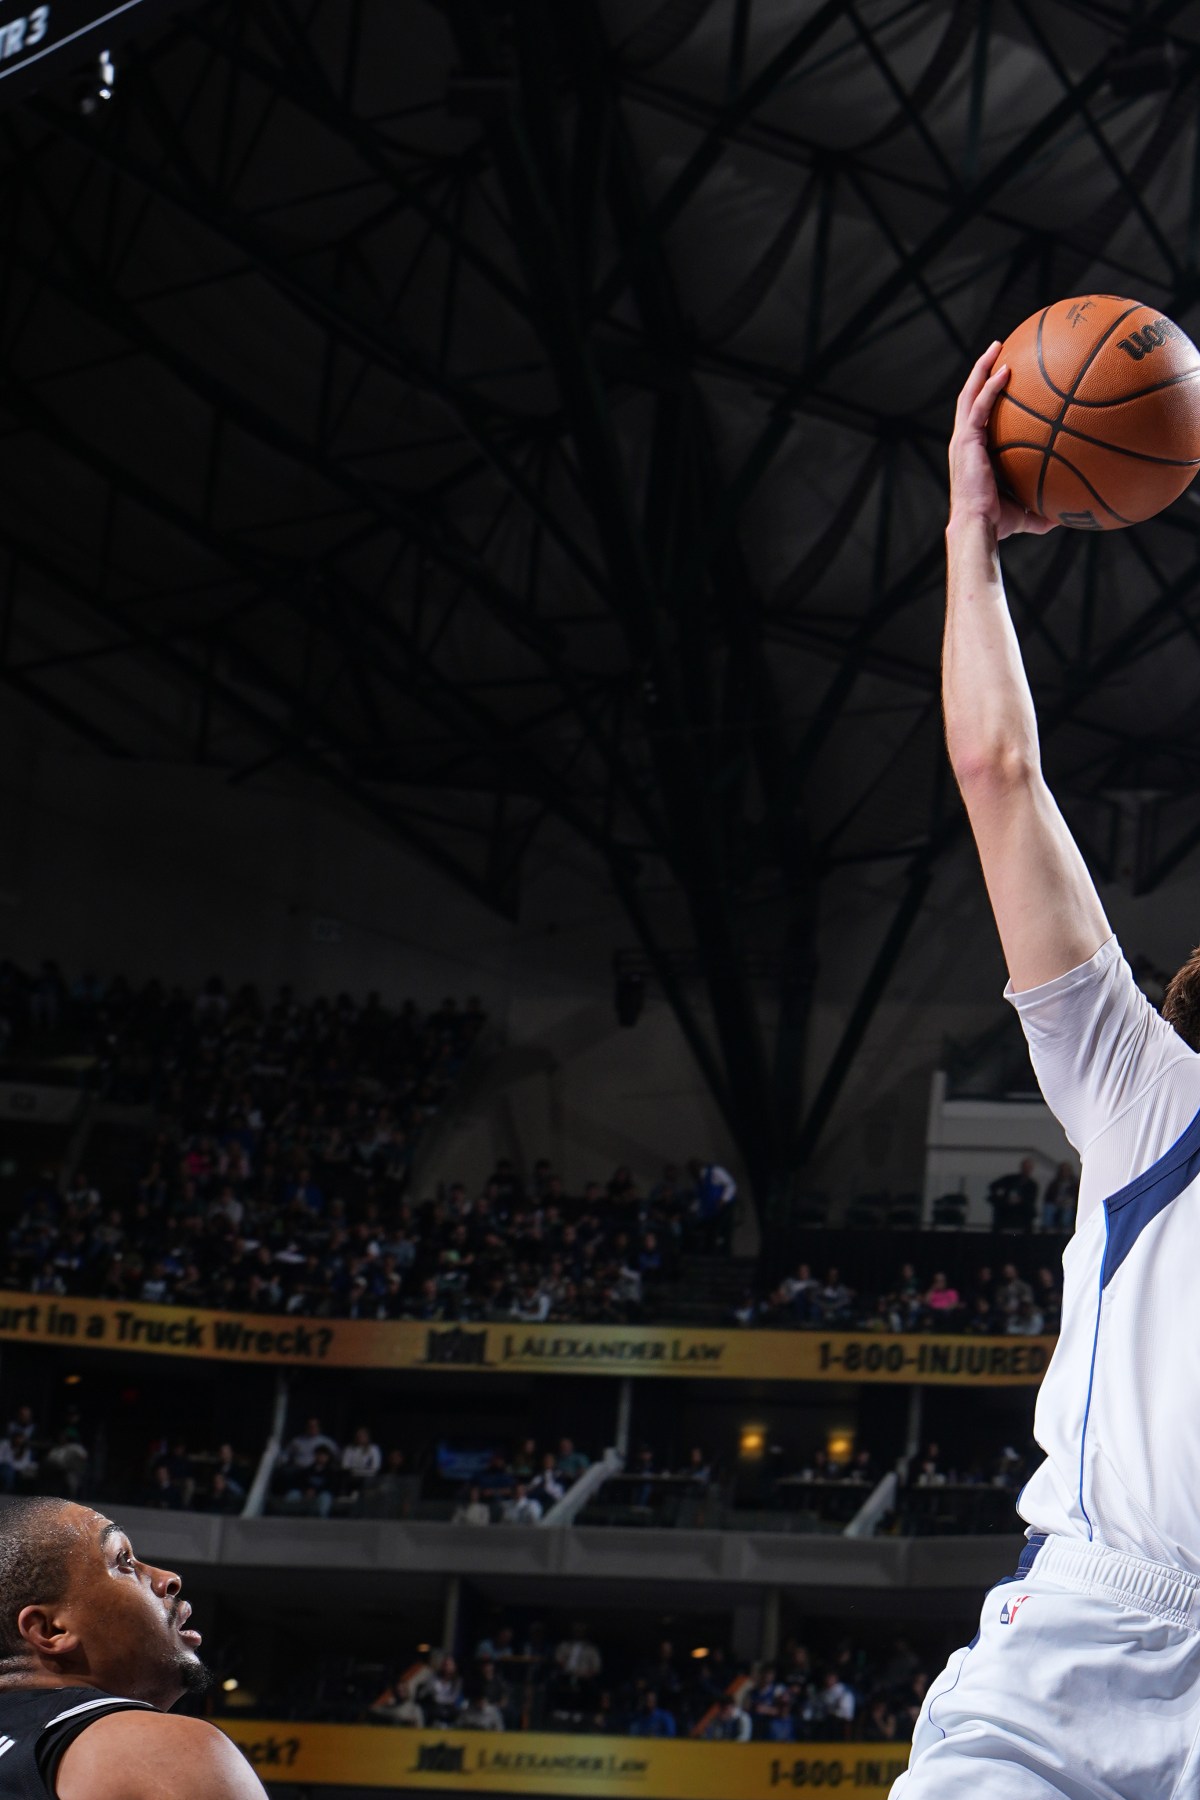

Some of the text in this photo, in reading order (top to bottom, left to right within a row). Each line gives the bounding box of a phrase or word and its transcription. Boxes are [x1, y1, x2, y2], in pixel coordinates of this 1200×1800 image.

[48, 1306, 77, 1335] in
[86, 1315, 105, 1338] a
[116, 1311, 203, 1348] Truck
[214, 1321, 333, 1357] Wreck?
[820, 1342, 1046, 1375] 1-800-INJURED
